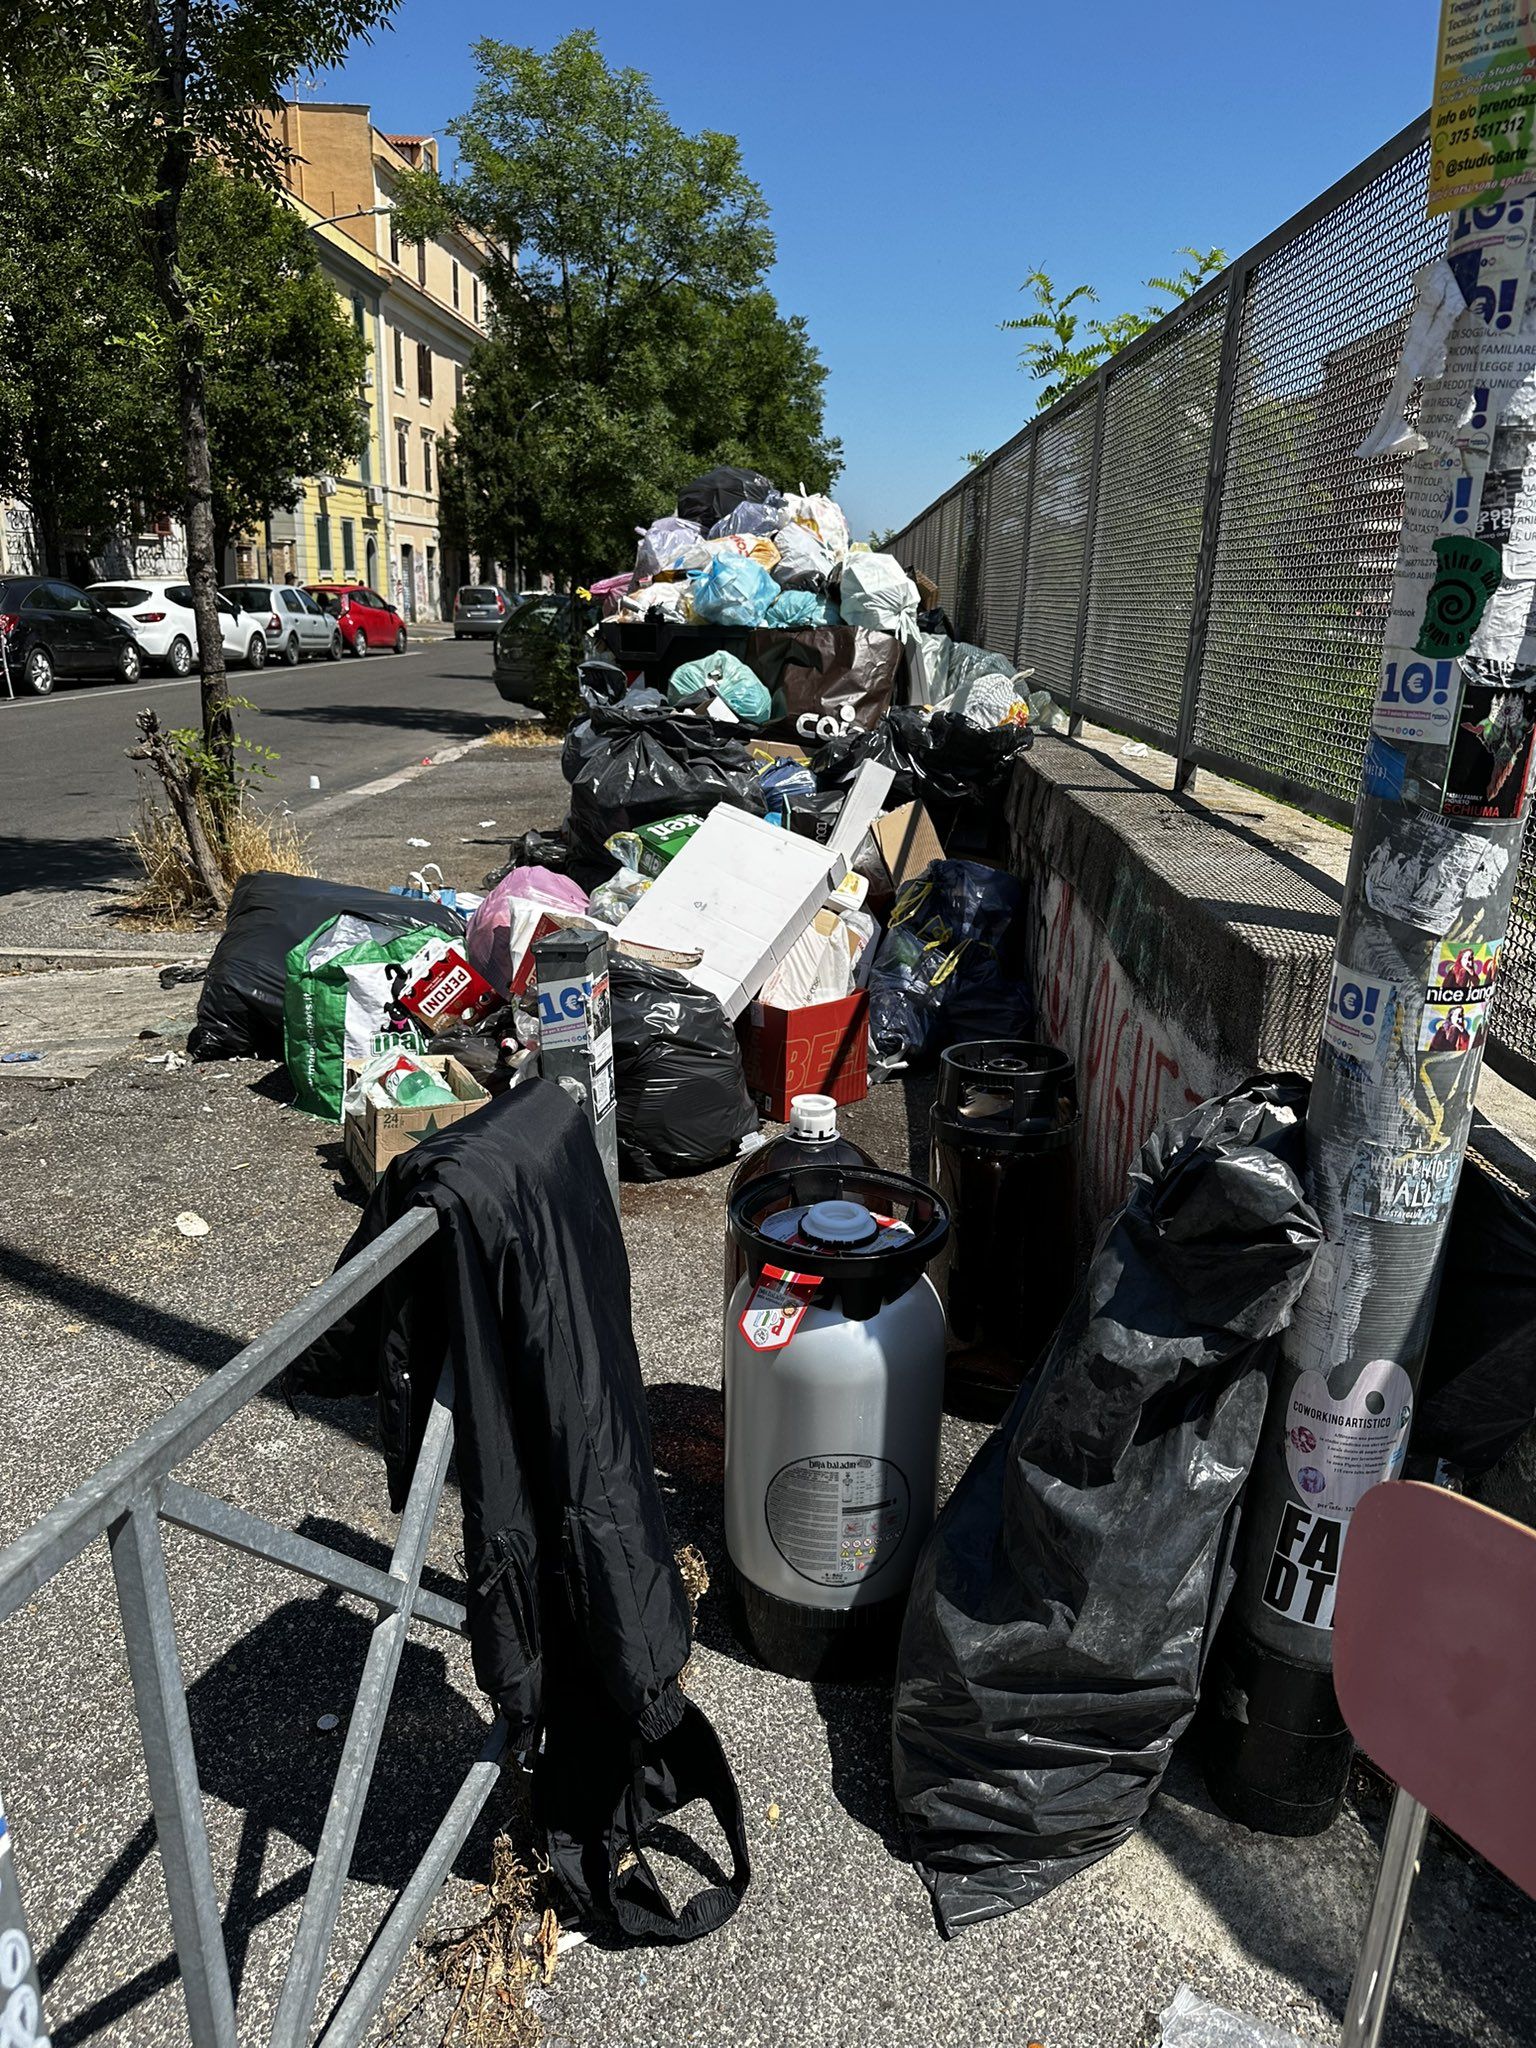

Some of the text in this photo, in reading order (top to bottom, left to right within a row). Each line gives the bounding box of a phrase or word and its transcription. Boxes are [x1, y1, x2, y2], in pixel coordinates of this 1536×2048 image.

[1437, 109, 1457, 128] info
[1459, 104, 1477, 120] e/o
[1449, 116, 1526, 146] 375 5517312
[1446, 147, 1529, 178] @studio6arte
[1479, 362, 1514, 373] LEGGE
[1443, 803, 1500, 817] SCHIUMA
[422, 969, 467, 1014] PERONI
[1427, 986, 1464, 1002] nice
[383, 1113, 399, 1124] 24
[1293, 1401, 1391, 1429] COWORKING ARTISTICO
[1262, 1552, 1336, 1624] DT
